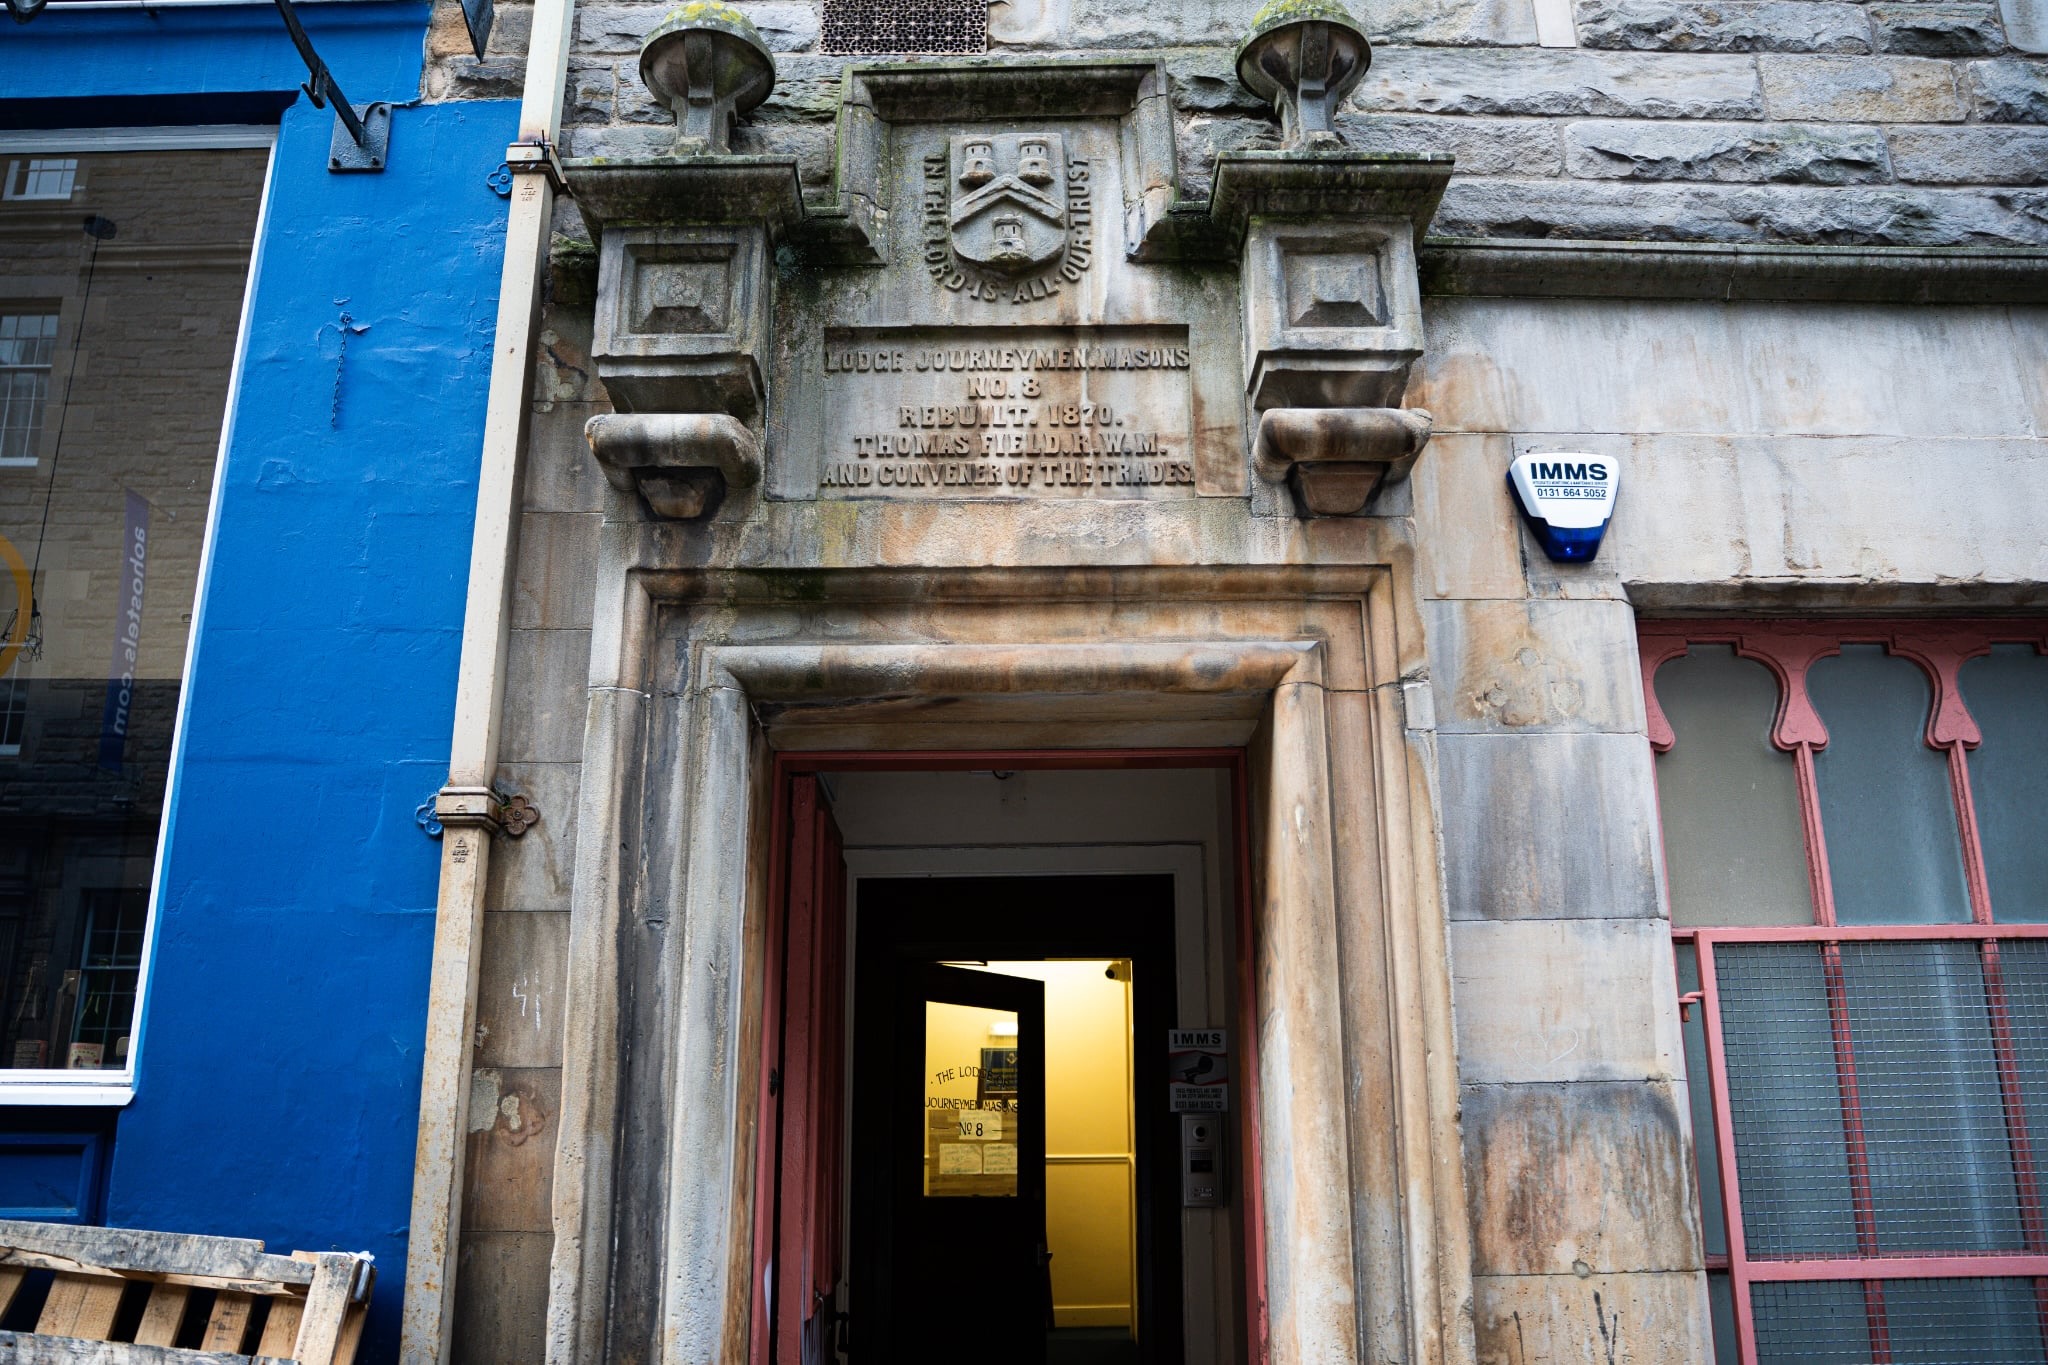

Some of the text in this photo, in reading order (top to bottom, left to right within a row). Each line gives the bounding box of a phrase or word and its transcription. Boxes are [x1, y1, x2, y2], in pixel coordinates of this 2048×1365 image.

[924, 154, 946, 178] IN
[1068, 154, 1091, 229] TRUST
[1061, 239, 1091, 283] OUR
[970, 279, 998, 302] IS
[1011, 277, 1060, 304] ALL
[1098, 349, 1190, 370] MASONS
[968, 377, 1041, 399] NO. 8
[900, 402, 1122, 428] REBUILT. 1870.
[854, 434, 970, 458] THOMAS
[821, 461, 1196, 487] AND CONVENER OF THE TRADES.
[1530, 463, 1608, 480] IMMS
[1537, 488, 1606, 498] 0131 664 5052
[1174, 1033, 1221, 1044] IMMS
[936, 1068, 955, 1085] THE
[959, 1066, 994, 1081] LODGE
[925, 1097, 1018, 1113] JOURNEYMEN MASONS
[976, 1122, 984, 1137] 8
